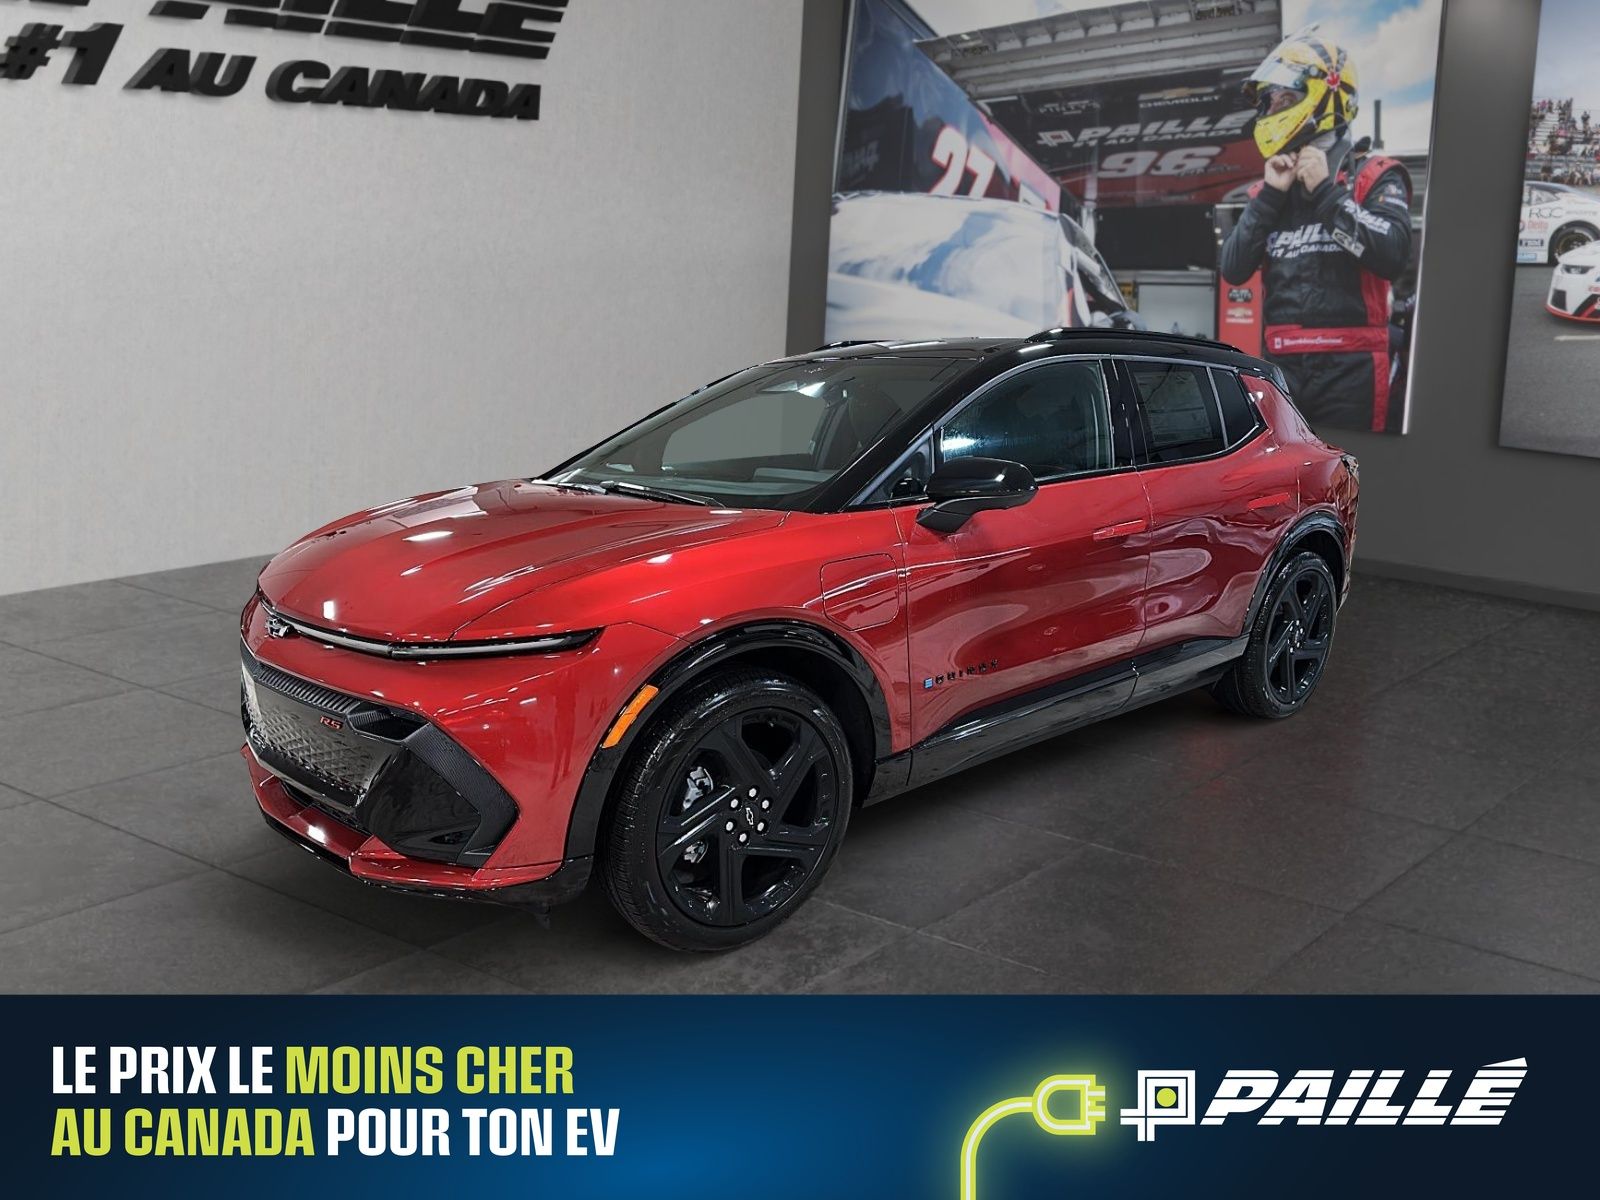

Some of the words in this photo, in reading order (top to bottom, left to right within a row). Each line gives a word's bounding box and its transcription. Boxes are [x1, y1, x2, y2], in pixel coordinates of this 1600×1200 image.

[0, 23, 124, 85] #1
[123, 48, 257, 97] AU
[265, 60, 541, 120] CANADA
[1139, 95, 1219, 108] CHEVROLET
[1142, 128, 1242, 142] CANADA
[1097, 146, 1222, 178] 96
[320, 715, 343, 730] RS
